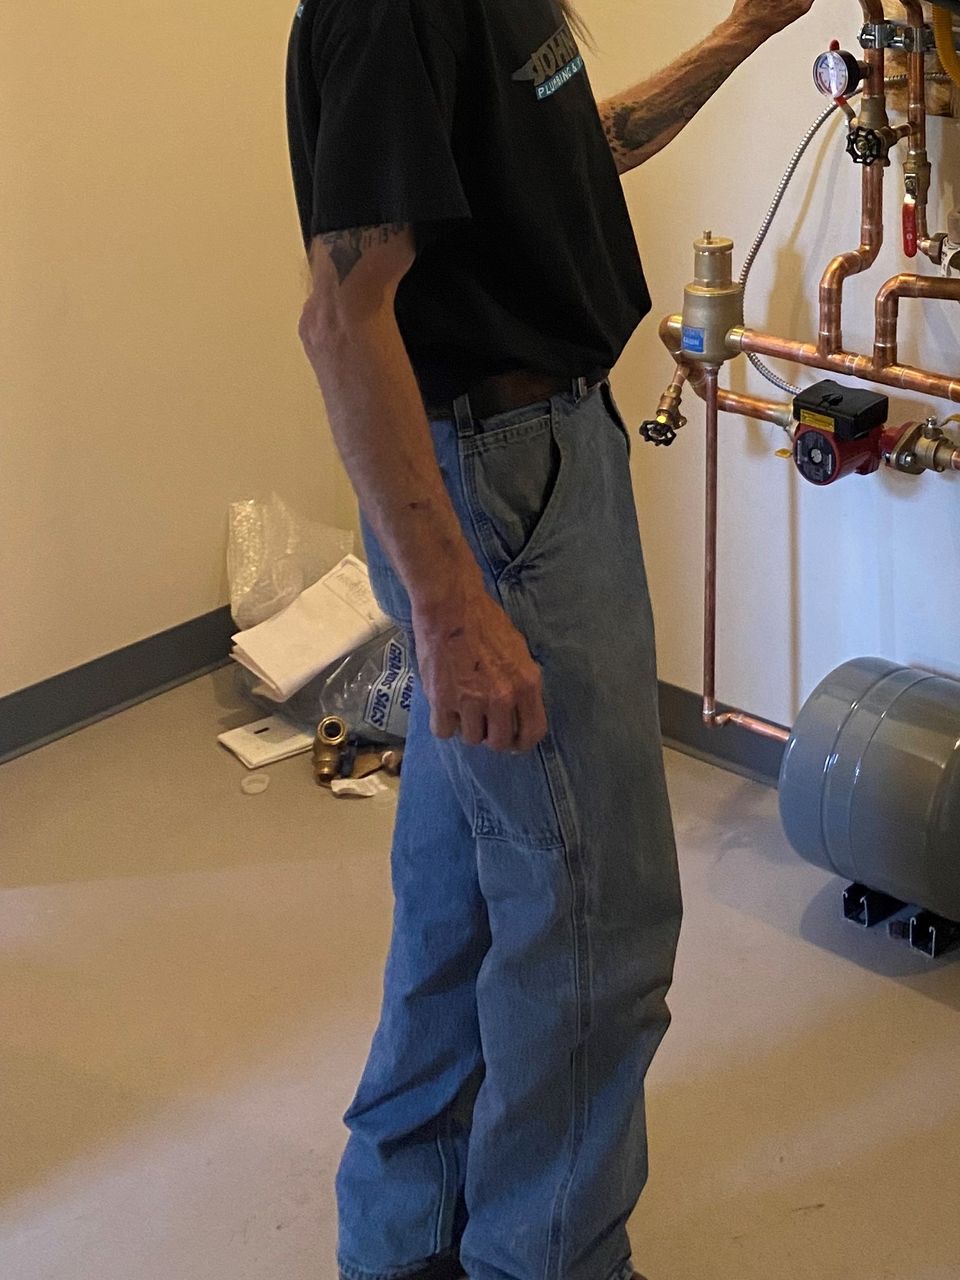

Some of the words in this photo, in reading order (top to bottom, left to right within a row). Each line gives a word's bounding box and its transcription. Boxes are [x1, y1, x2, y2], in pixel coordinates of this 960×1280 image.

[538, 66, 571, 98] PLUMBING
[381, 642, 402, 689] GRANDS
[370, 688, 390, 727] SACS
